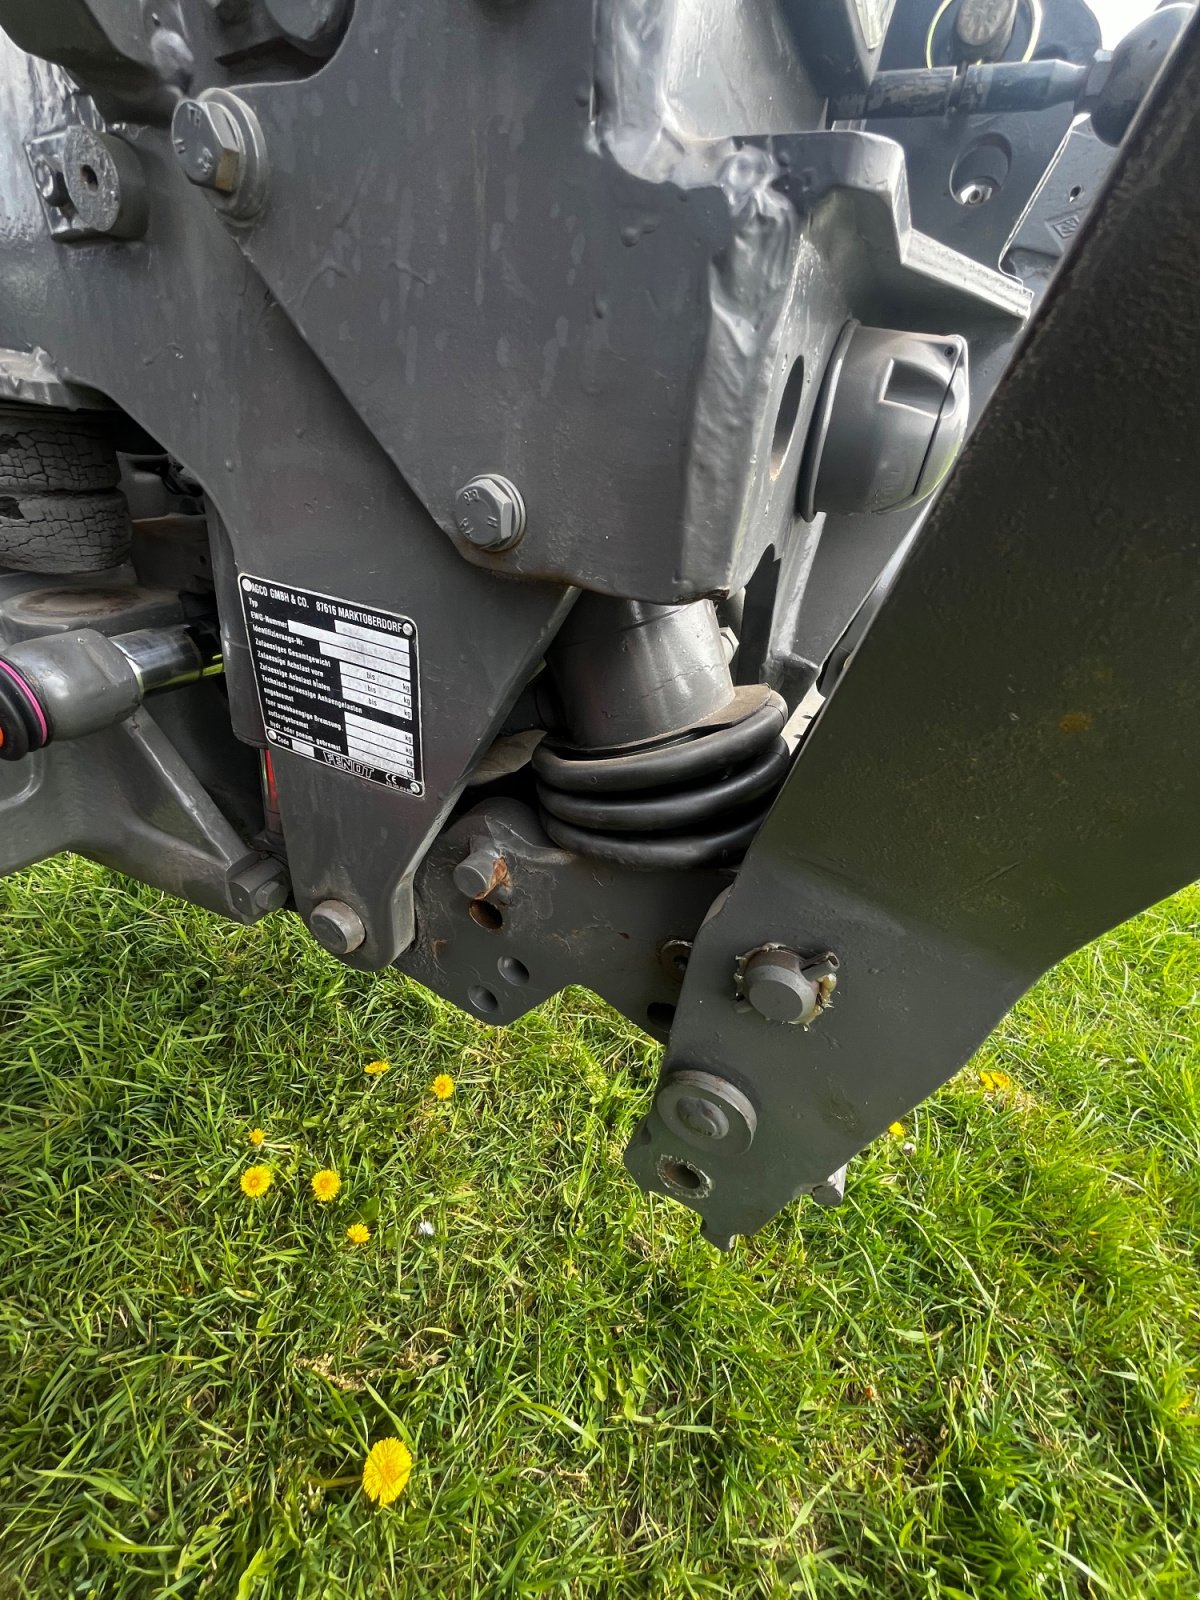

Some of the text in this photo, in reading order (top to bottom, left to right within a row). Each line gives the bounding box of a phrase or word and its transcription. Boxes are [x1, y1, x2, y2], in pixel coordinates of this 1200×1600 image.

[248, 597, 258, 608] Typ
[269, 588, 289, 602] GMBH
[290, 593, 296, 604] &
[297, 595, 309, 608] CO.
[316, 600, 336, 615] 87616
[337, 606, 402, 633] MARKTOBERDORF
[287, 647, 330, 668] Gesamtgewicht
[366, 671, 375, 680] bis
[402, 682, 409, 692] kg
[286, 659, 310, 673] Achslast
[367, 684, 376, 694] bis
[403, 696, 410, 706] kg
[288, 672, 311, 685] Achslast
[368, 697, 377, 706] bis
[404, 709, 410, 718] kg
[277, 735, 289, 745] Code
[405, 734, 411, 743] kg
[405, 746, 412, 755] kg
[322, 749, 374, 779] FENDT
[406, 758, 412, 767] kg
